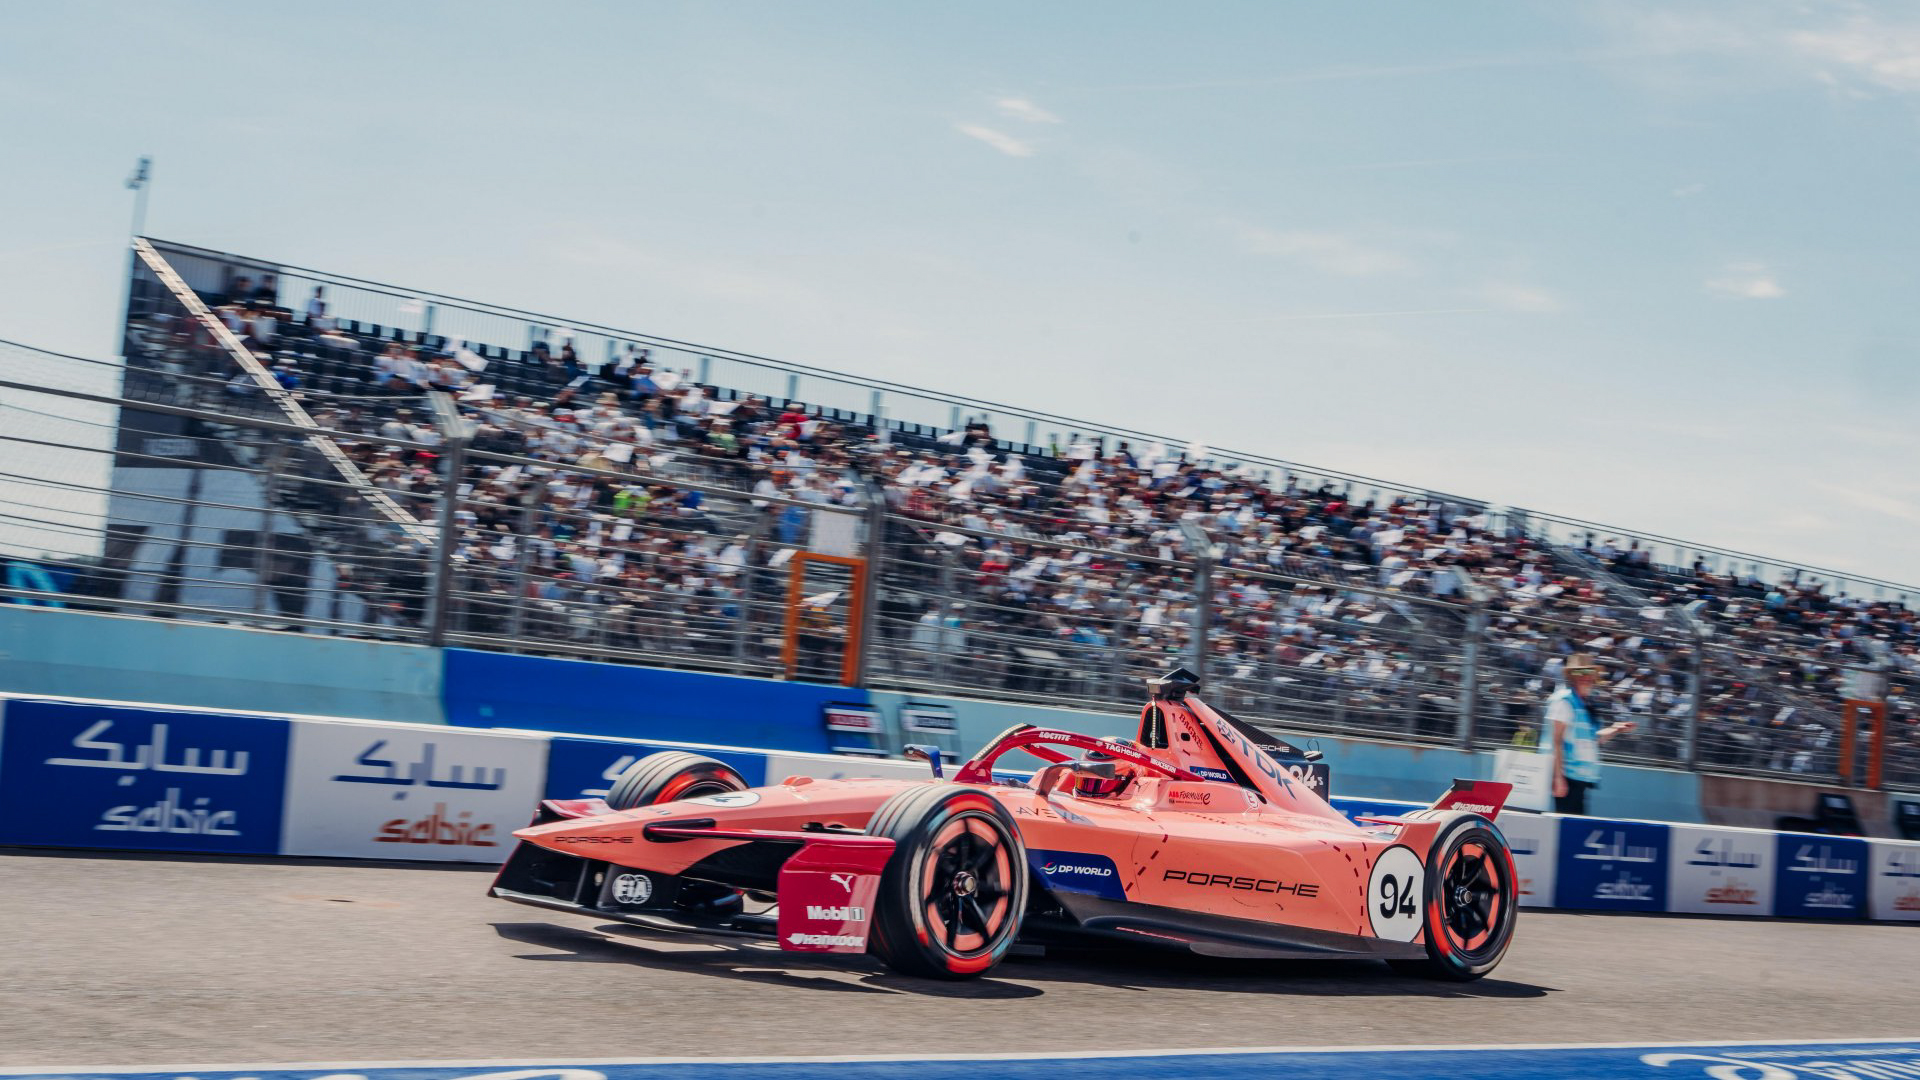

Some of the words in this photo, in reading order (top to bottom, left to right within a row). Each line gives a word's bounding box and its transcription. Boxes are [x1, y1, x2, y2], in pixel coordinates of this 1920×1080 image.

[44, 719, 249, 787] سابك
[1039, 731, 1071, 741] LOCTITE
[330, 739, 507, 800] سابك
[1234, 731, 1297, 800] TDK
[94, 787, 242, 836] sabic
[371, 802, 499, 847] sabic
[554, 836, 634, 844] PORSCHE
[615, 879, 648, 898] FIA
[1058, 865, 1073, 873] DP
[1074, 866, 1112, 876] WORLD
[1163, 870, 1320, 898] PORSCHE
[806, 906, 849, 920] Mobil
[1379, 873, 1416, 919] 94
